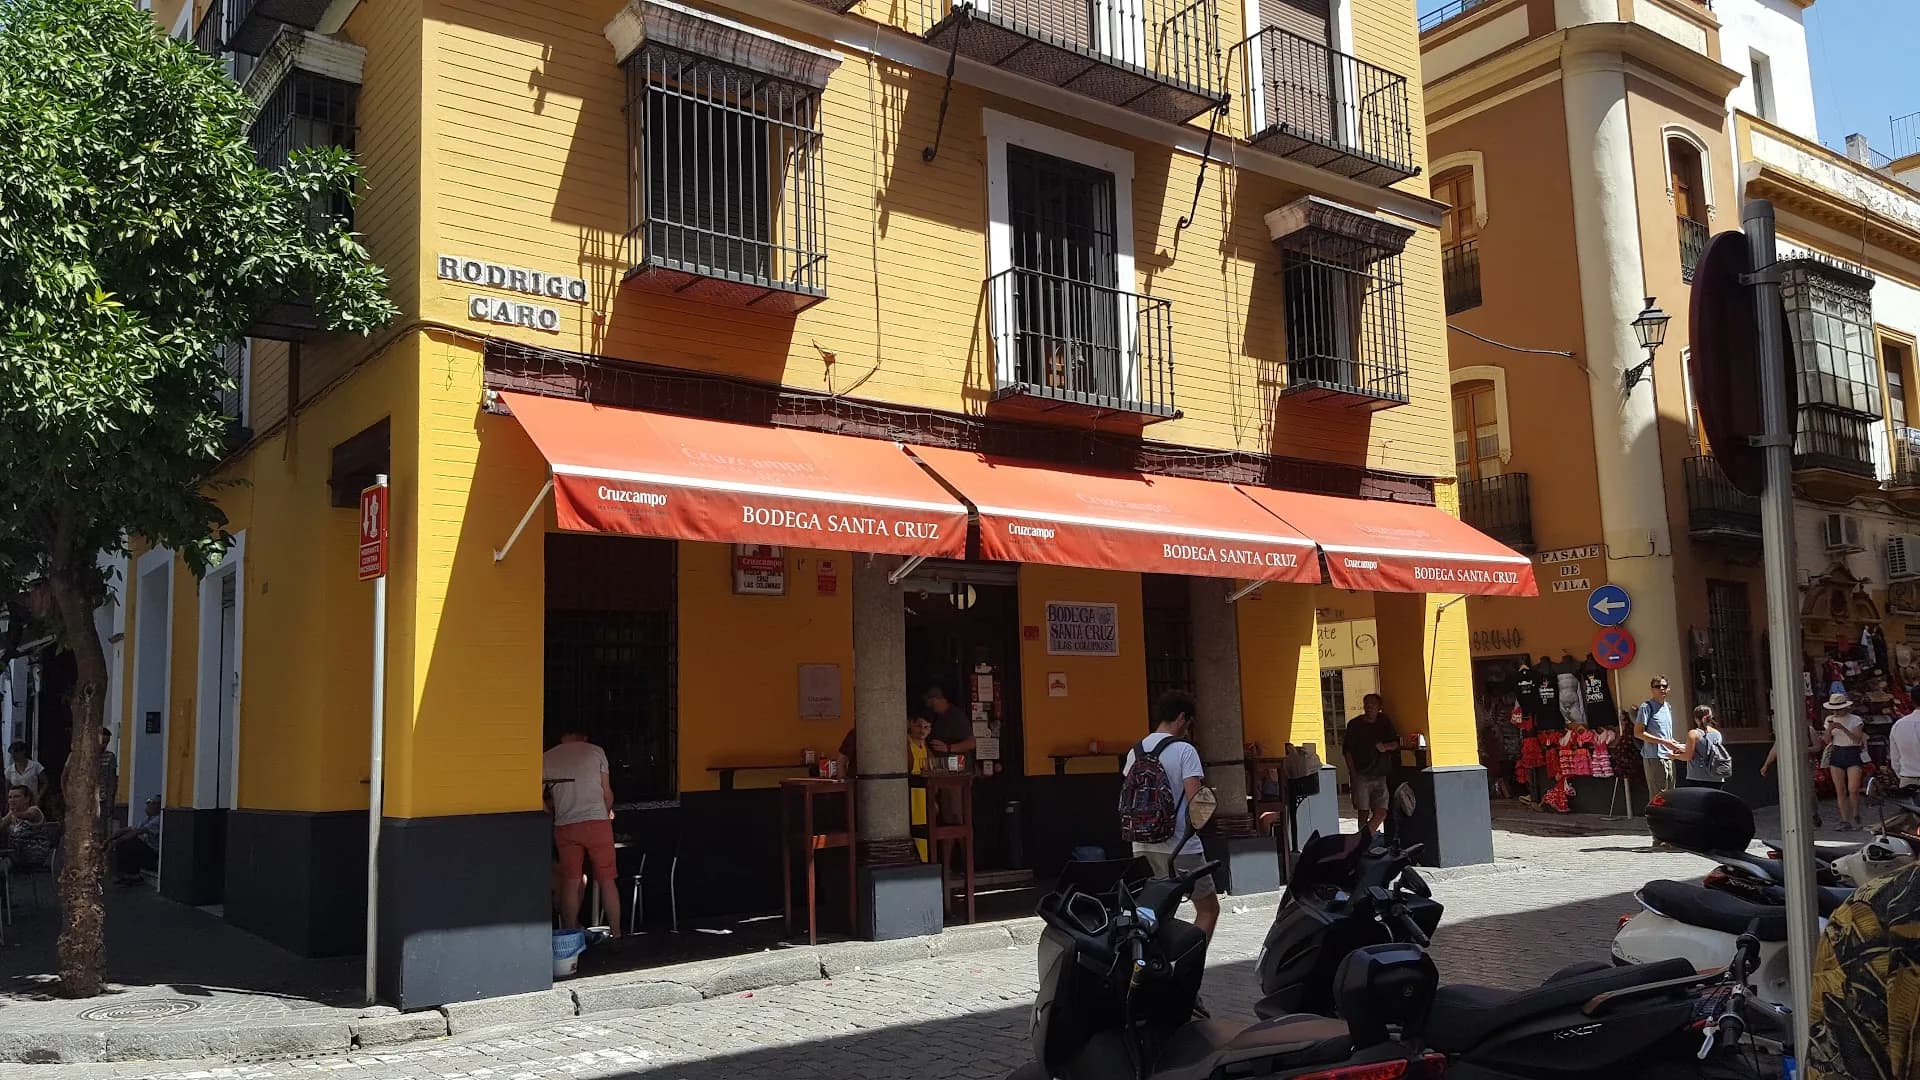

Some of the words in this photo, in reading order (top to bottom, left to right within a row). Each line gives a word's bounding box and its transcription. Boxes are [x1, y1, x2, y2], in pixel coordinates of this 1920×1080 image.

[439, 256, 587, 300] RODRIGO
[471, 297, 557, 329] CARO
[597, 485, 668, 507] Cruzcampo
[742, 505, 823, 531] BODEGA
[828, 515, 889, 537] SANTA
[894, 521, 939, 539] CRUZ
[1008, 522, 1056, 540] Cruzcampo
[1163, 543, 1217, 562] BODEGA
[1220, 548, 1263, 565] SANTA
[1265, 552, 1297, 568] CRUZ
[1542, 547, 1598, 562] PASAJE
[1344, 557, 1378, 571] Cruzcampo
[1561, 564, 1579, 576] DE
[1414, 566, 1455, 581] BODEGA
[1457, 569, 1491, 583] SANTA
[1493, 571, 1519, 584] CRUZ
[1553, 579, 1589, 591] VILA
[1047, 604, 1096, 624] BODEGA
[1050, 623, 1083, 640] SANTA
[1085, 624, 1115, 641] CRUZ
[1553, 1023, 1603, 1041] K-XCT
